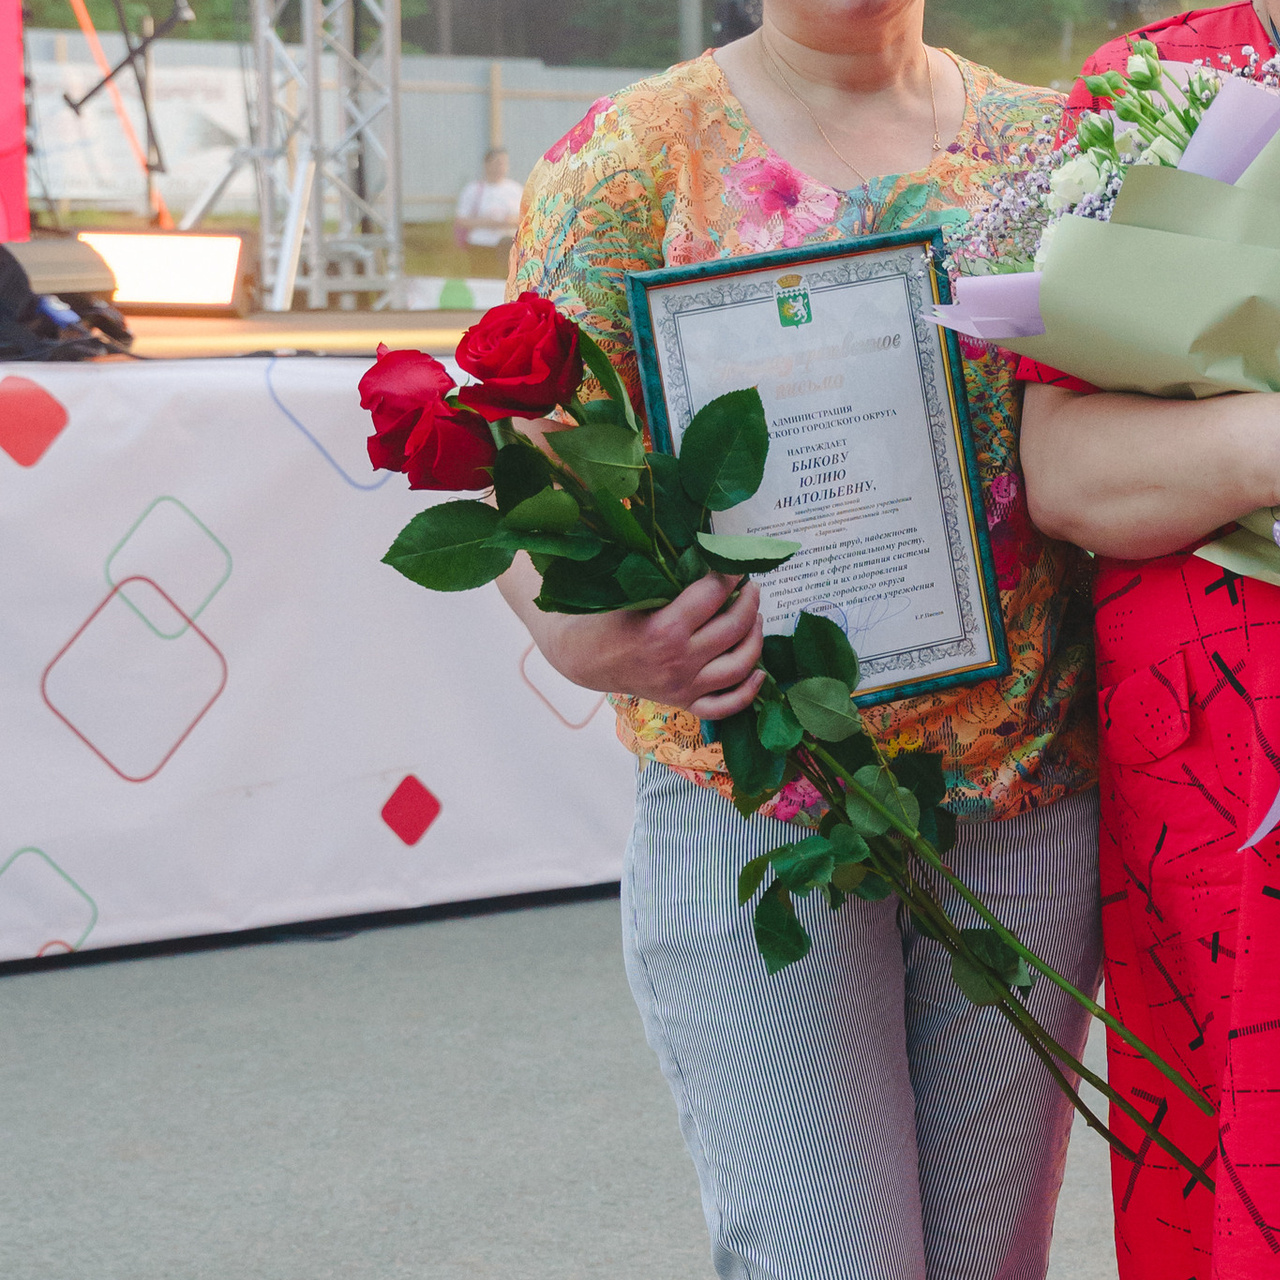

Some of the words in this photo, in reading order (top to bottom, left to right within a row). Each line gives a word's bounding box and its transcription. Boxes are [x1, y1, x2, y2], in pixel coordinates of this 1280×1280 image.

[771, 405, 853, 427] АДМИНИСТРАЦИЯ
[801, 415, 861, 434] ГОРОДСКОГО
[862, 409, 897, 421] ОКРУГА
[787, 438, 847, 457] НАГРАЖДАЕТ
[791, 451, 849, 473] БЫКОВУ
[800, 468, 847, 488] ЮЛИЮ
[773, 480, 877, 510] АНАТОЛЬЕВНУ,
[795, 542, 837, 557] овестный
[840, 537, 863, 550] труд,
[864, 527, 918, 543] надежность
[812, 543, 896, 565] профессиональному
[778, 571, 818, 585] качество
[826, 563, 851, 580] сфере
[853, 556, 890, 569] питания
[892, 547, 930, 561] системы
[769, 586, 803, 598] отдыха
[805, 579, 831, 591] детей
[840, 576, 850, 584] их
[853, 564, 908, 581] оздоровления
[777, 592, 831, 609] Березовского
[832, 583, 877, 598] городского
[878, 576, 905, 588] округа
[766, 613, 789, 623] связи
[846, 593, 882, 606] юбилеем
[883, 581, 935, 600] учреждения
